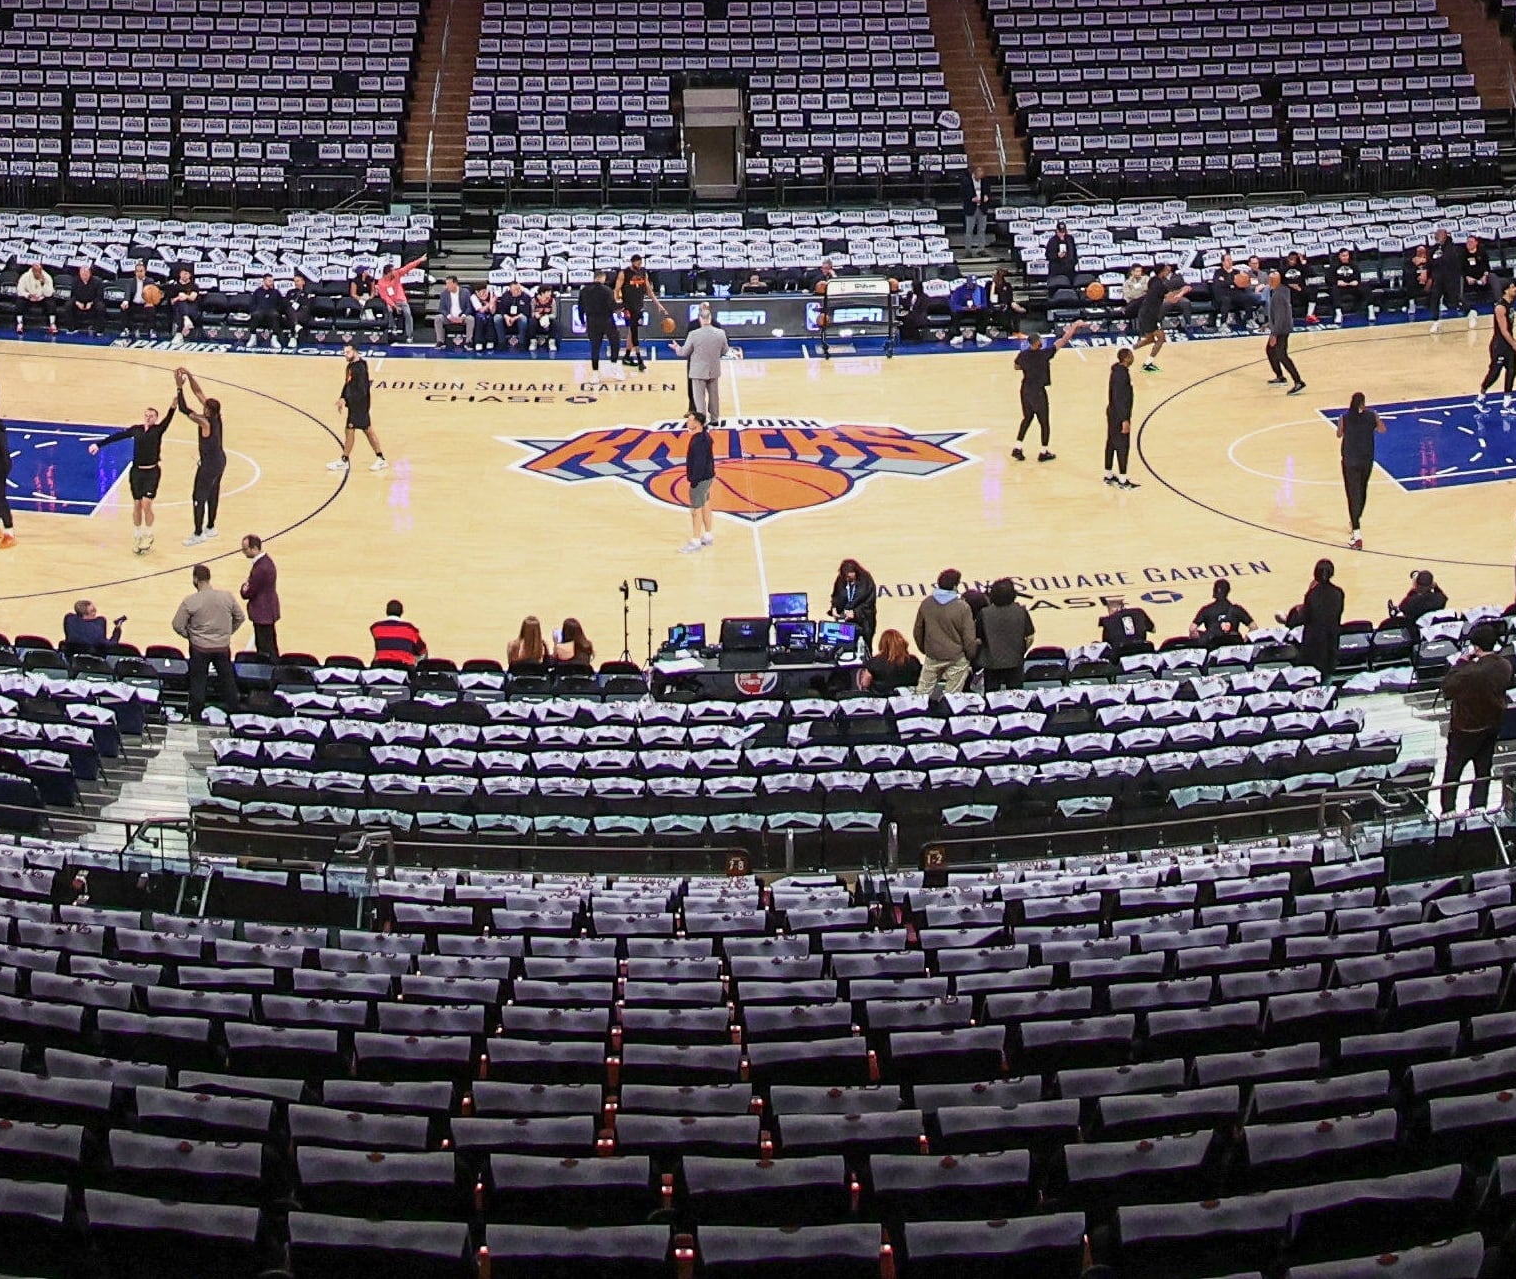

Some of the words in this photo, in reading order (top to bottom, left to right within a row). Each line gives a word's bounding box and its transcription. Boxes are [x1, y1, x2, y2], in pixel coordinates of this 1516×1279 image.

[717, 310, 767, 325] ESPN
[832, 307, 883, 324] ESPN
[129, 338, 232, 353] PLAYOFFS
[295, 347, 388, 358] Google
[475, 381, 566, 392] SQUARE
[580, 382, 676, 393] GARDEN
[425, 394, 555, 404] CHASE
[1142, 560, 1272, 584] GARDEN
